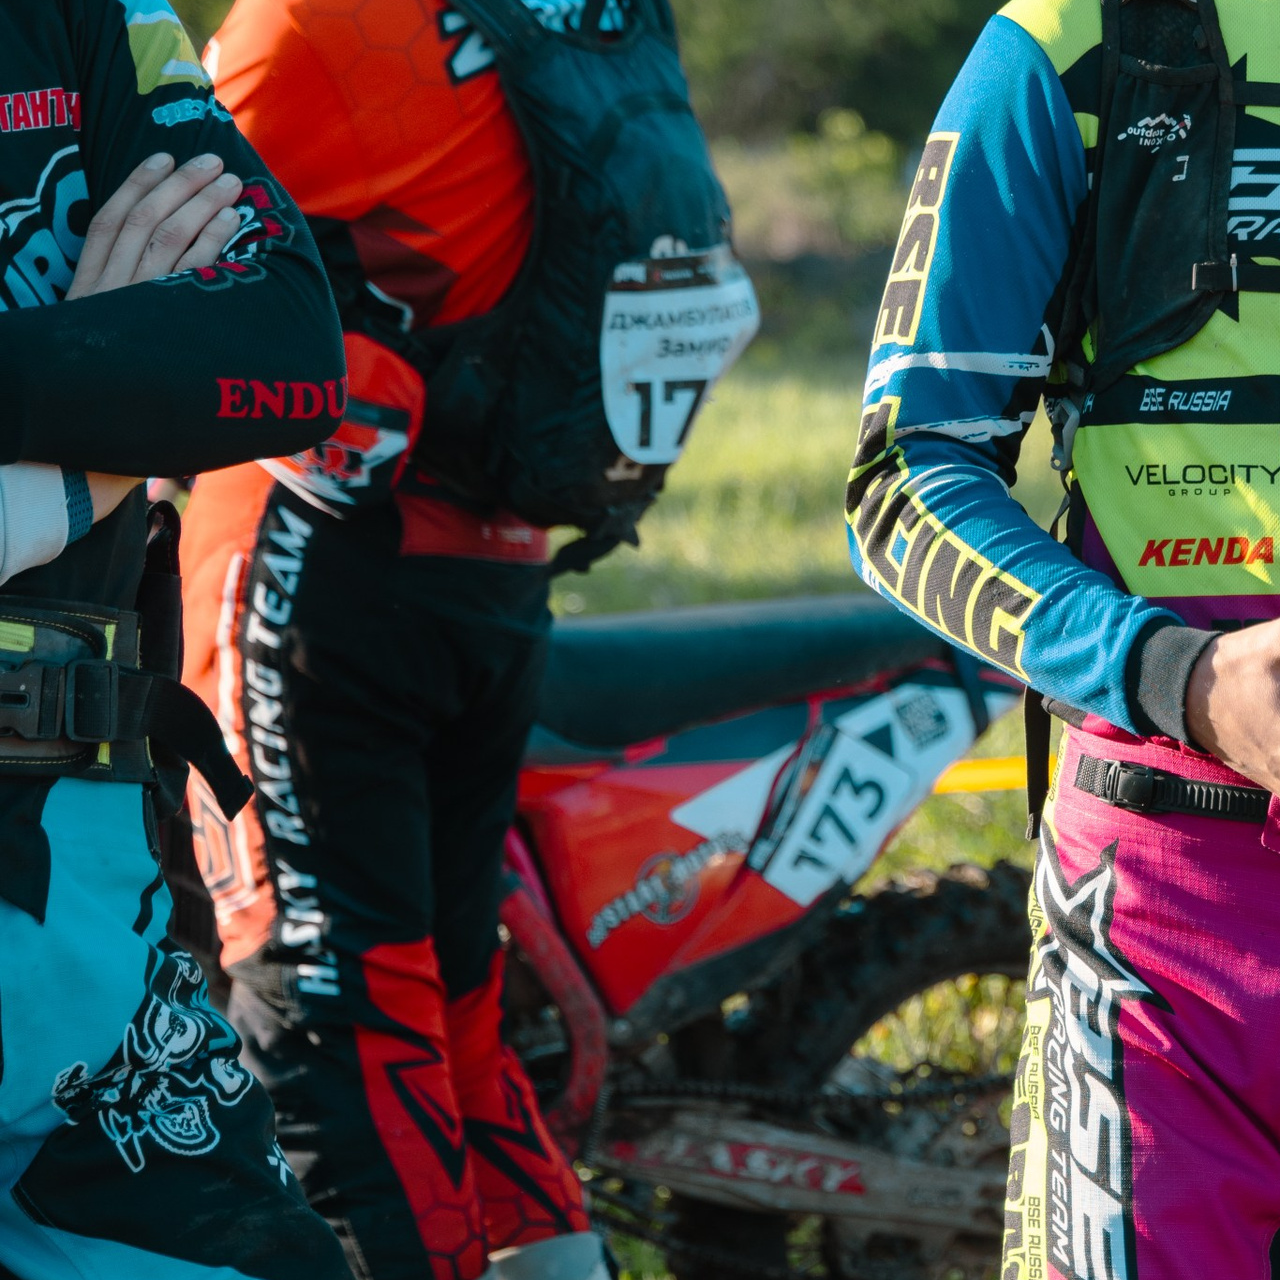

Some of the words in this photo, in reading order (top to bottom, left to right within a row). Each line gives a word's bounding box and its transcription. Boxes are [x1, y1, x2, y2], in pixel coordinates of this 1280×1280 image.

[872, 131, 961, 348] BSE
[1139, 387, 1166, 412] BSE
[1167, 389, 1232, 412] RUSSIA
[1168, 488, 1231, 497] GROUP
[247, 504, 315, 649] TEAM
[1138, 536, 1275, 568] KENDA
[245, 671, 310, 851] RACING
[792, 765, 886, 874] 173
[1047, 976, 1069, 1133] RACING
[1027, 1196, 1041, 1229] BSE
[1050, 1148, 1070, 1268] TEAM
